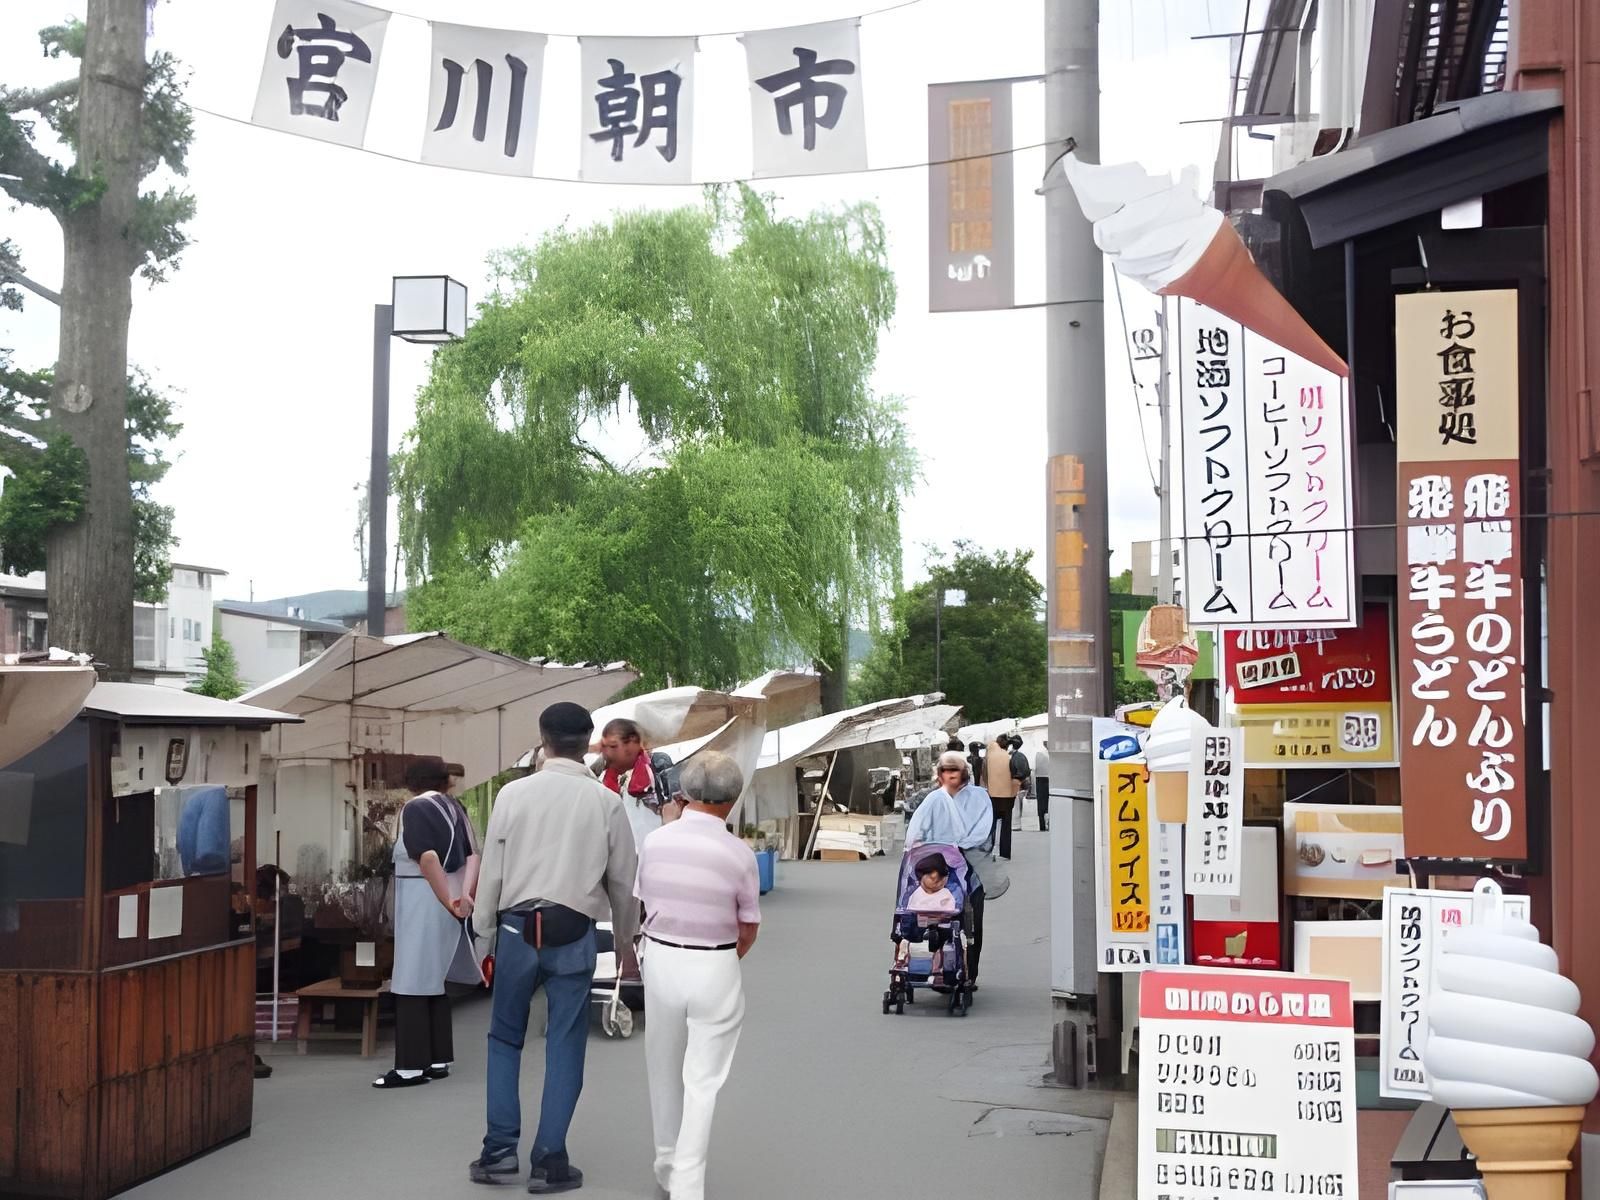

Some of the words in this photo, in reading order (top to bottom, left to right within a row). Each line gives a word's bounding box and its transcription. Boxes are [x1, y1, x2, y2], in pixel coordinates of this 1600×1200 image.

[277, 13, 856, 161] 宮川朝市
[1408, 475, 1459, 747] 飛牛うどん
[1463, 474, 1516, 841] 飛牛のどんぶり
